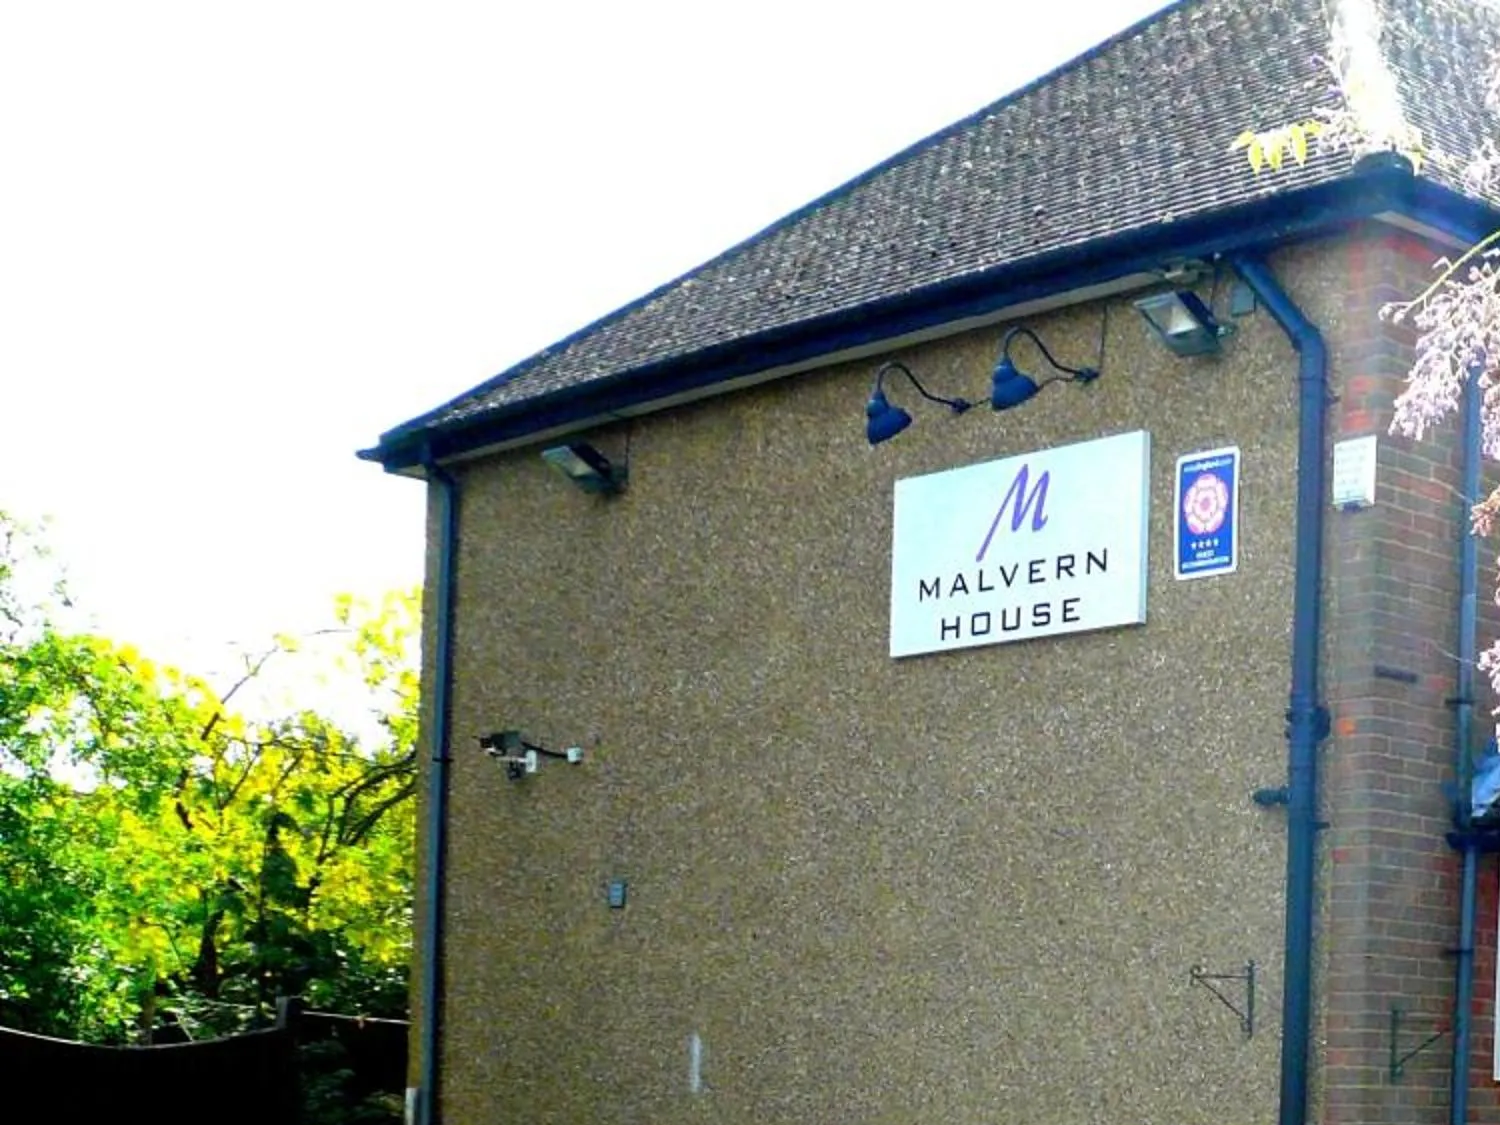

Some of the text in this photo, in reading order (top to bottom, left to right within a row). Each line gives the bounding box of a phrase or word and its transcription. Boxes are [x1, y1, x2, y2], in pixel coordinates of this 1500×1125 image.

[976, 463, 1050, 562] M
[919, 548, 1108, 601] MALVERN
[941, 597, 1081, 641] HOUSE
